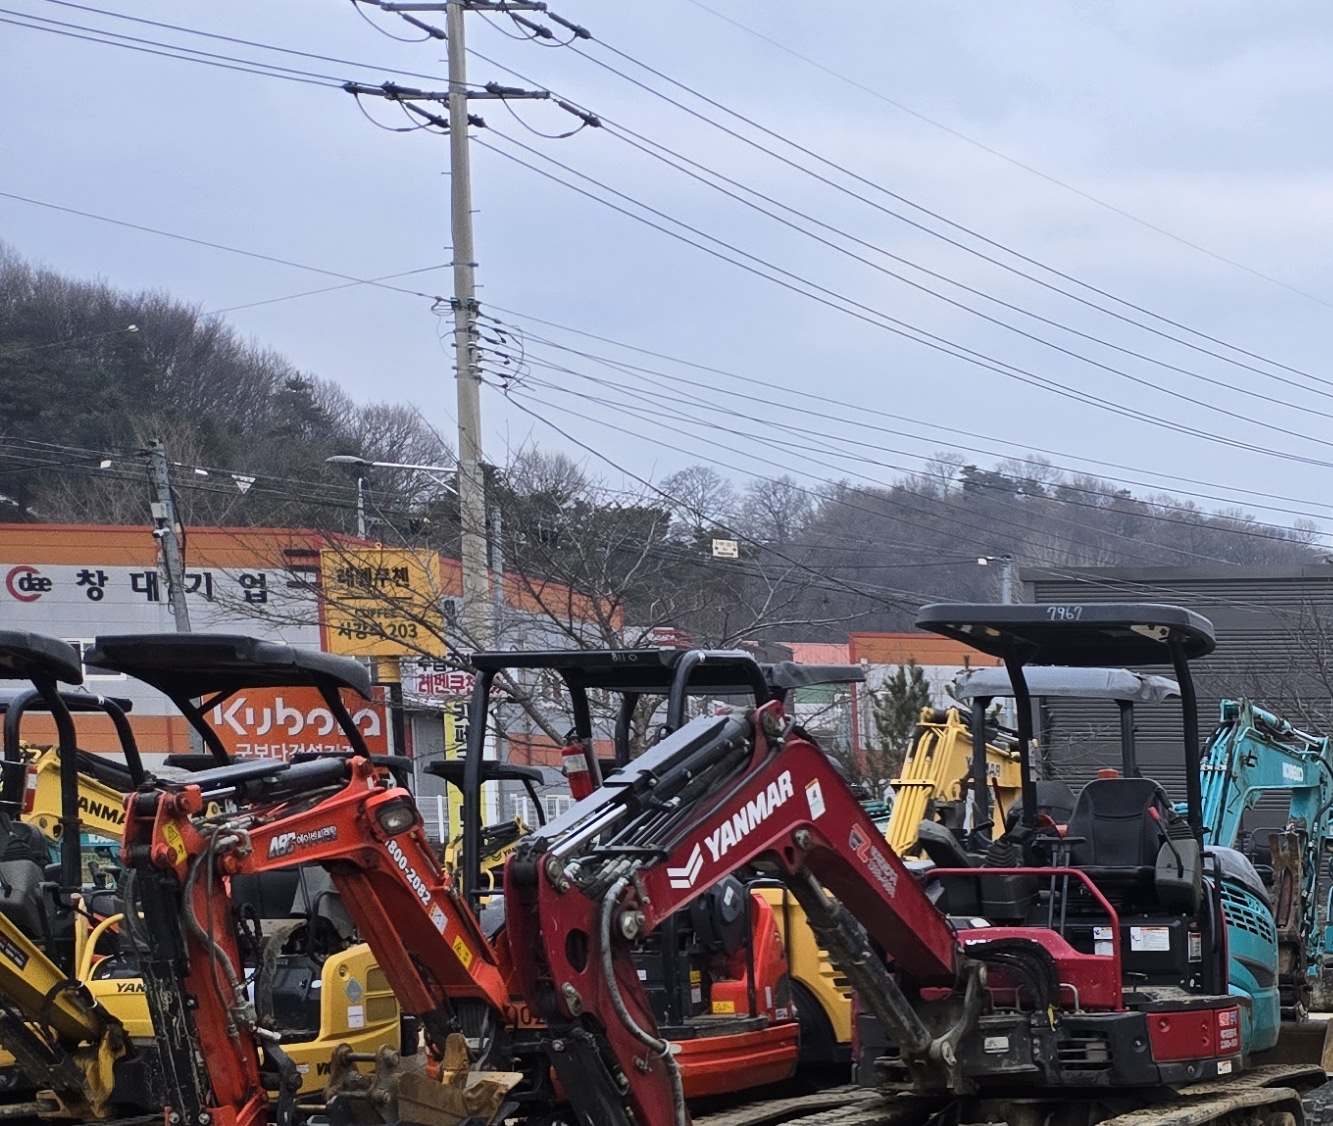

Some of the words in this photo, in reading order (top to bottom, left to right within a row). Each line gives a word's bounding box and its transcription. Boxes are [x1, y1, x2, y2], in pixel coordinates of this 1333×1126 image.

[1046, 606, 1083, 621] 7967
[389, 623, 418, 639] 203
[78, 796, 126, 825] ANMA
[703, 770, 795, 862] YANMAR
